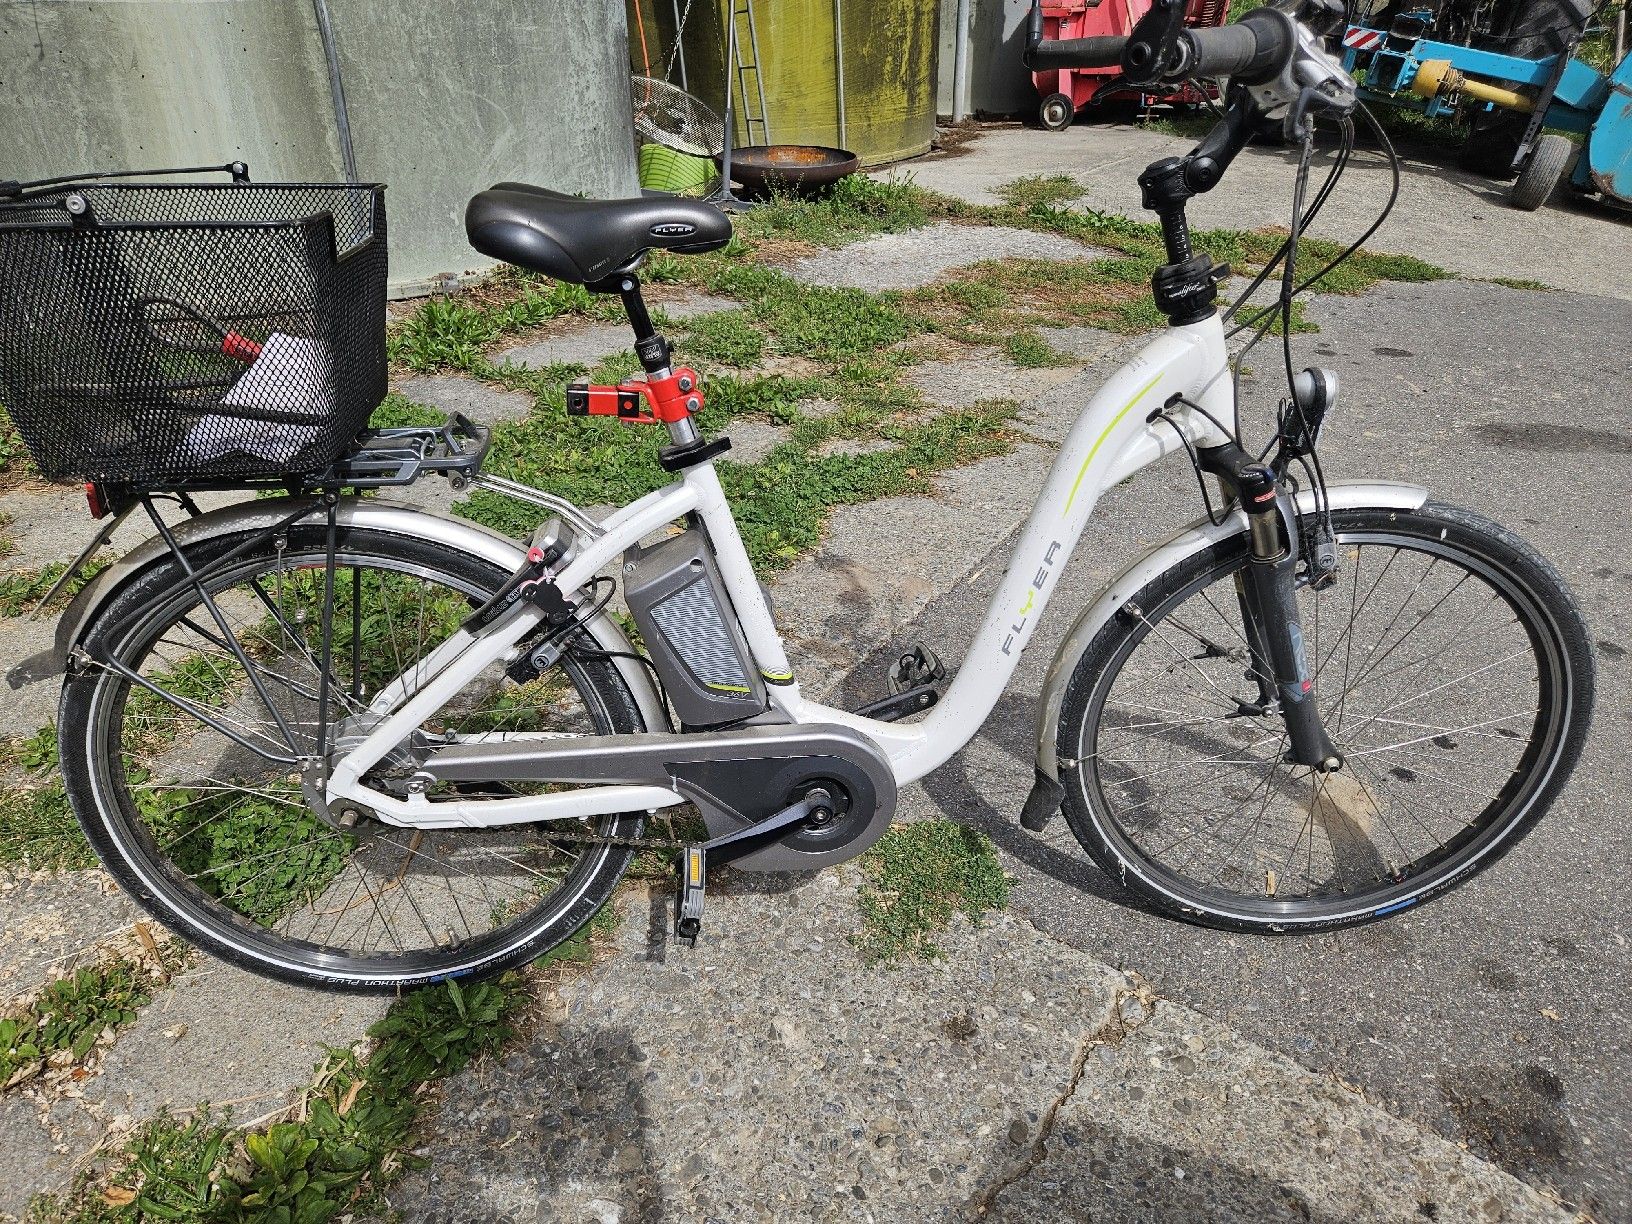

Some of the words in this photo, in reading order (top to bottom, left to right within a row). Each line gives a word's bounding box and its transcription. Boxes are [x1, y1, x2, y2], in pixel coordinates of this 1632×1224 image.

[1001, 540, 1062, 656] FLYER
[476, 941, 534, 971] SCHWALBE
[327, 977, 360, 985] PLUS
[364, 977, 428, 987] MARATHON
